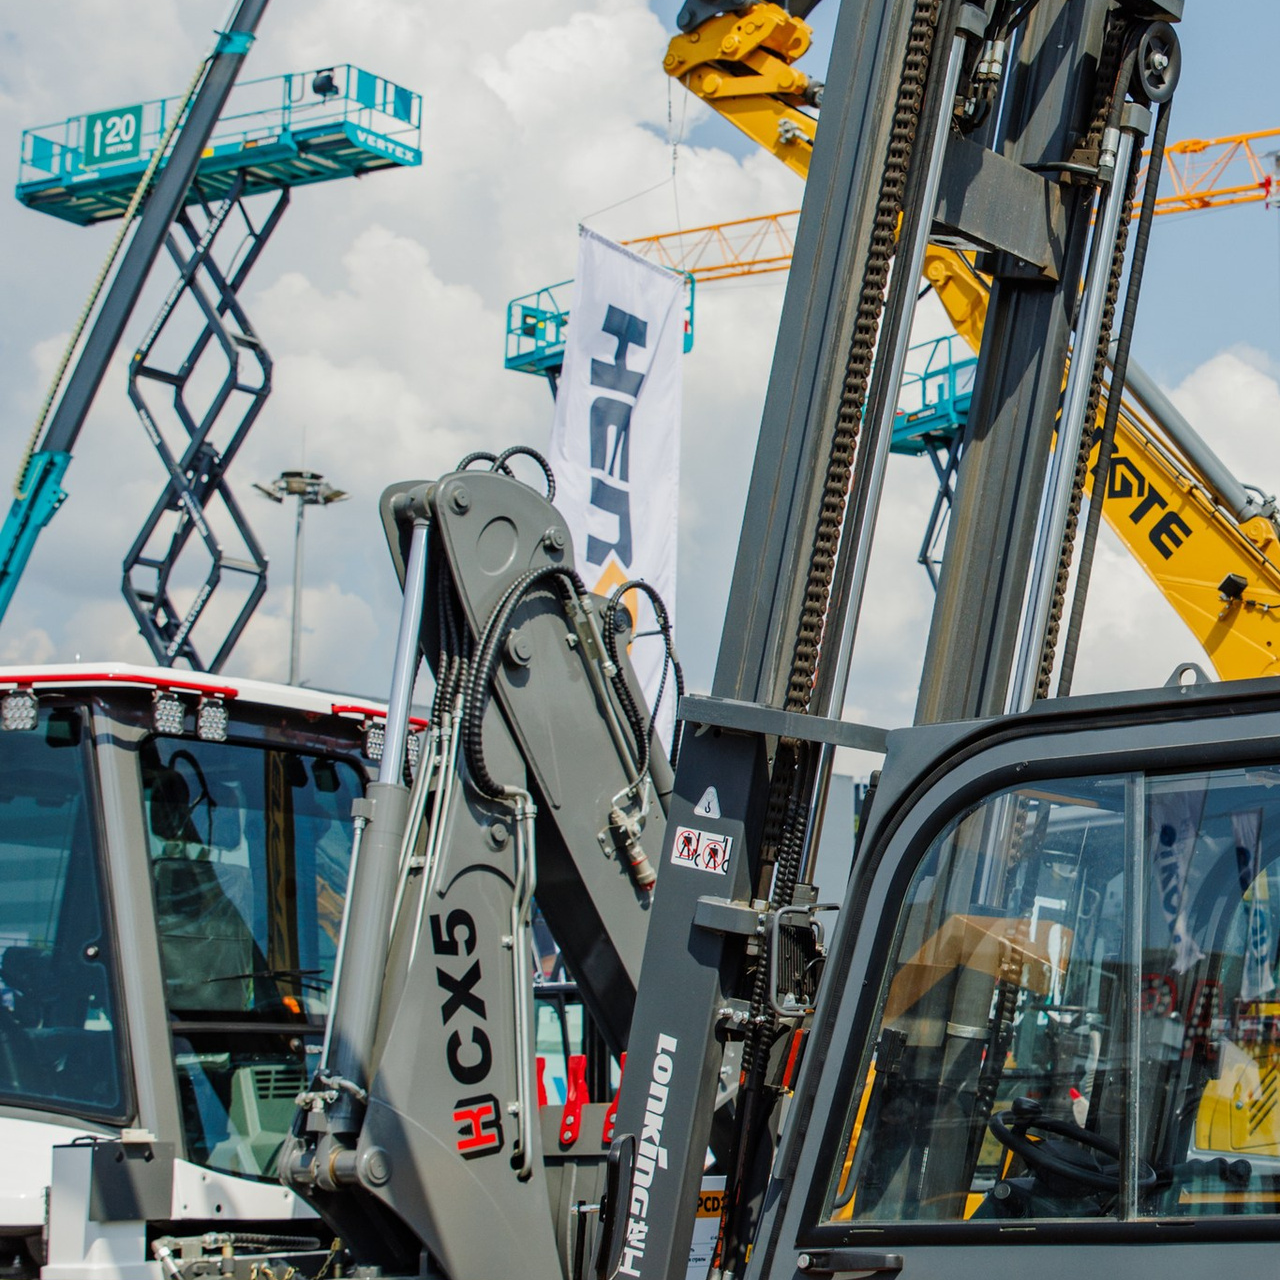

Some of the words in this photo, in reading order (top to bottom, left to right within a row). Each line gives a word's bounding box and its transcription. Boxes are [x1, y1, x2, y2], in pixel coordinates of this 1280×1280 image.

[104, 113, 136, 144] 20
[355, 129, 415, 163] VERTEX
[630, 1033, 678, 1219] LONKING
